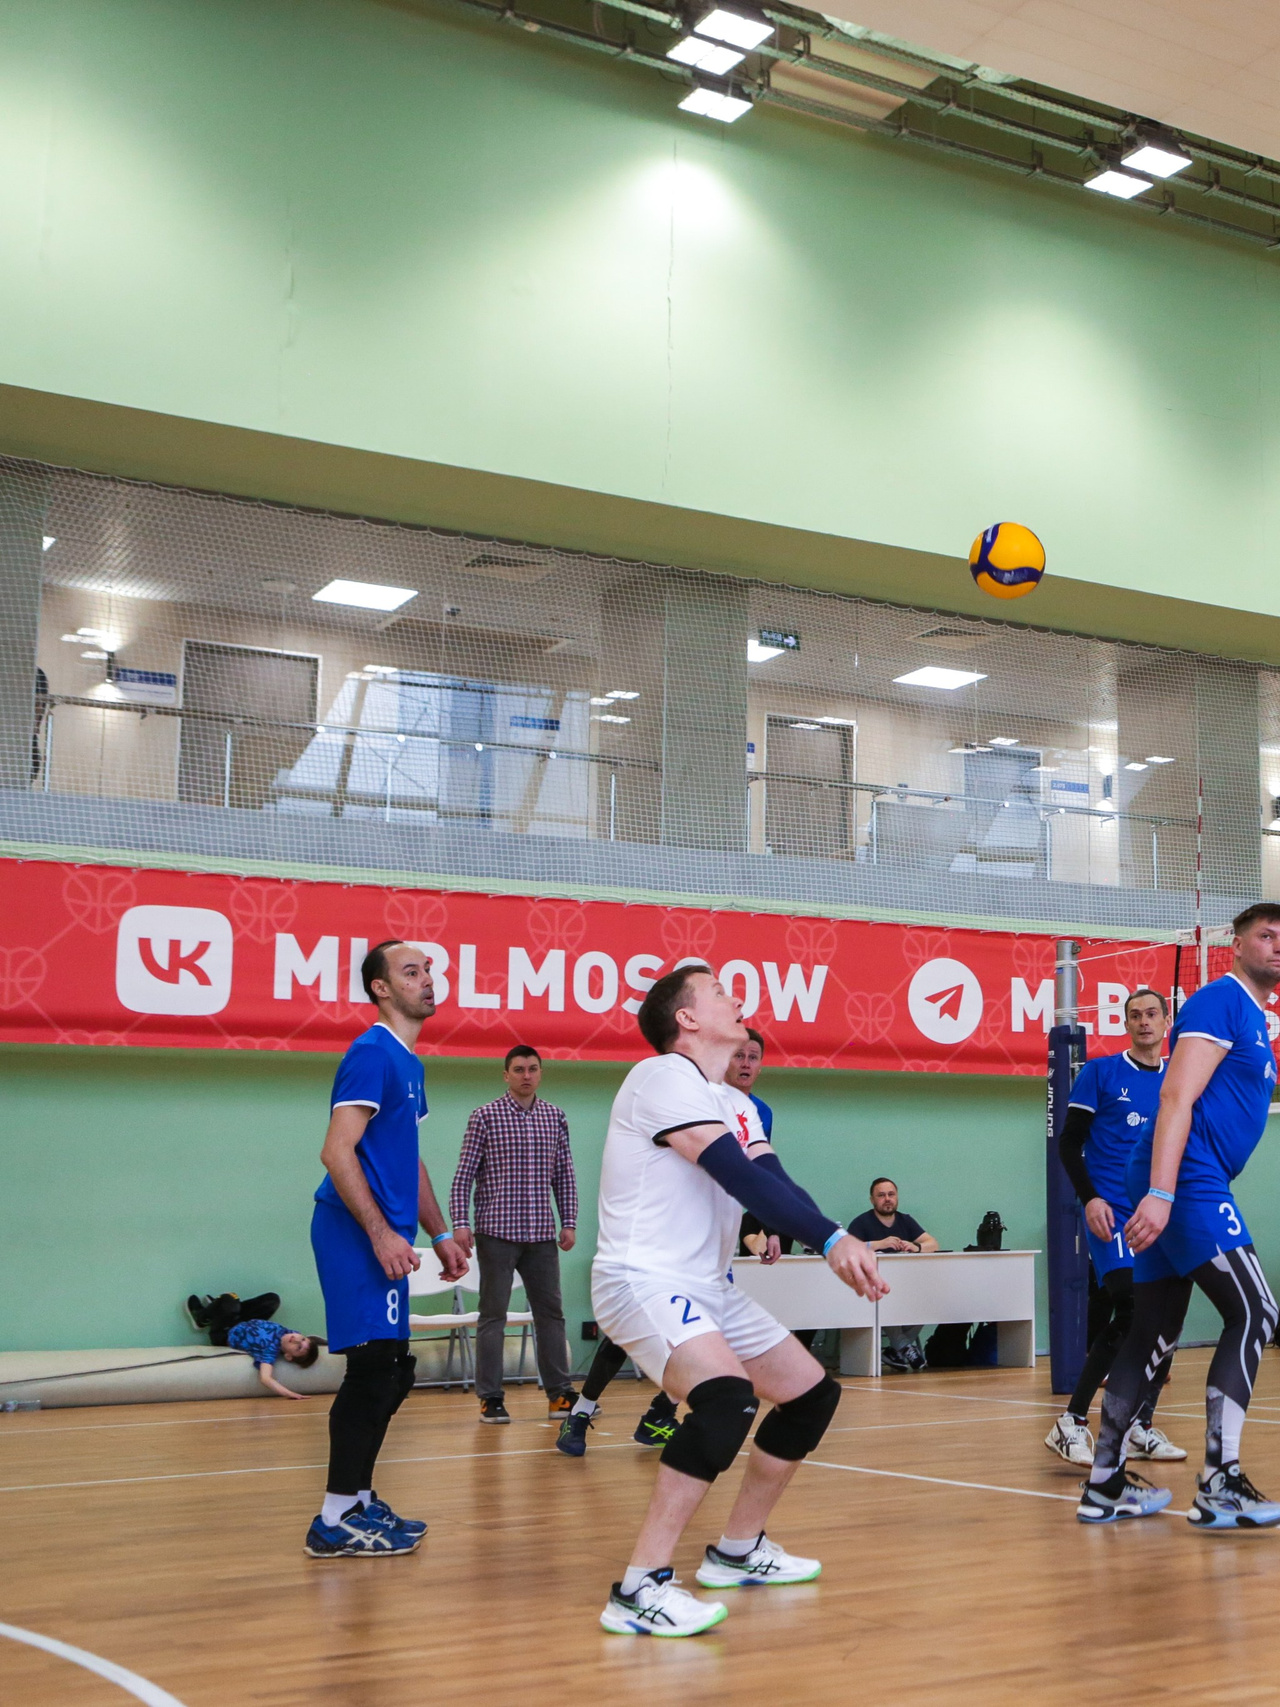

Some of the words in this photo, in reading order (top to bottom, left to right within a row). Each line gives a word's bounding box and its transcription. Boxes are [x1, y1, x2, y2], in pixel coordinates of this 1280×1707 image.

[137, 936, 212, 987] VK
[273, 932, 829, 1023] MLBLMOSOW
[1218, 1202, 1242, 1236] 3
[386, 1288, 400, 1325] 8
[670, 1294, 701, 1325] 2
